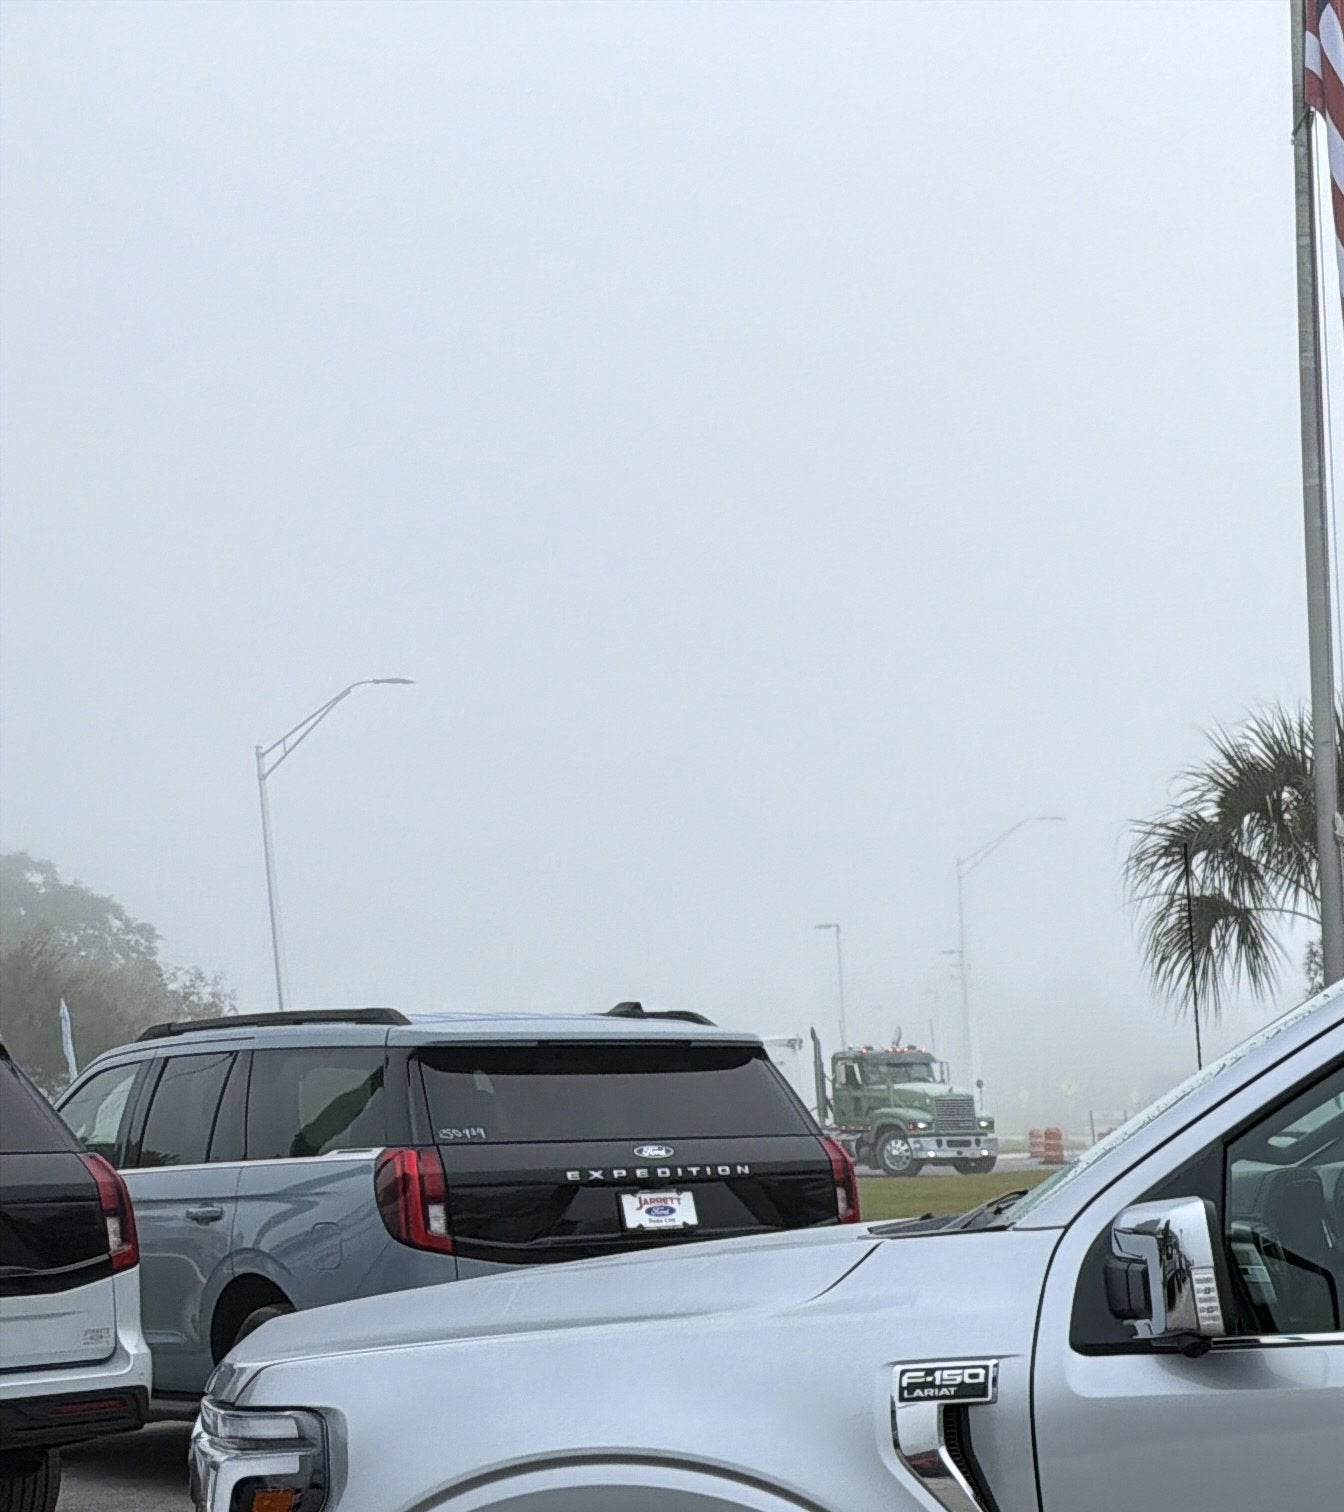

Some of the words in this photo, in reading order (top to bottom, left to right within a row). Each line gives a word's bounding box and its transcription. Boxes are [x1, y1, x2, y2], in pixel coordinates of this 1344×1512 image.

[565, 1164, 750, 1181] EXPEDITION
[635, 1196, 682, 1211] JARRETT
[650, 1206, 671, 1216] Ford
[901, 1367, 986, 1387] F-150
[903, 1387, 958, 1398] LARIAT
